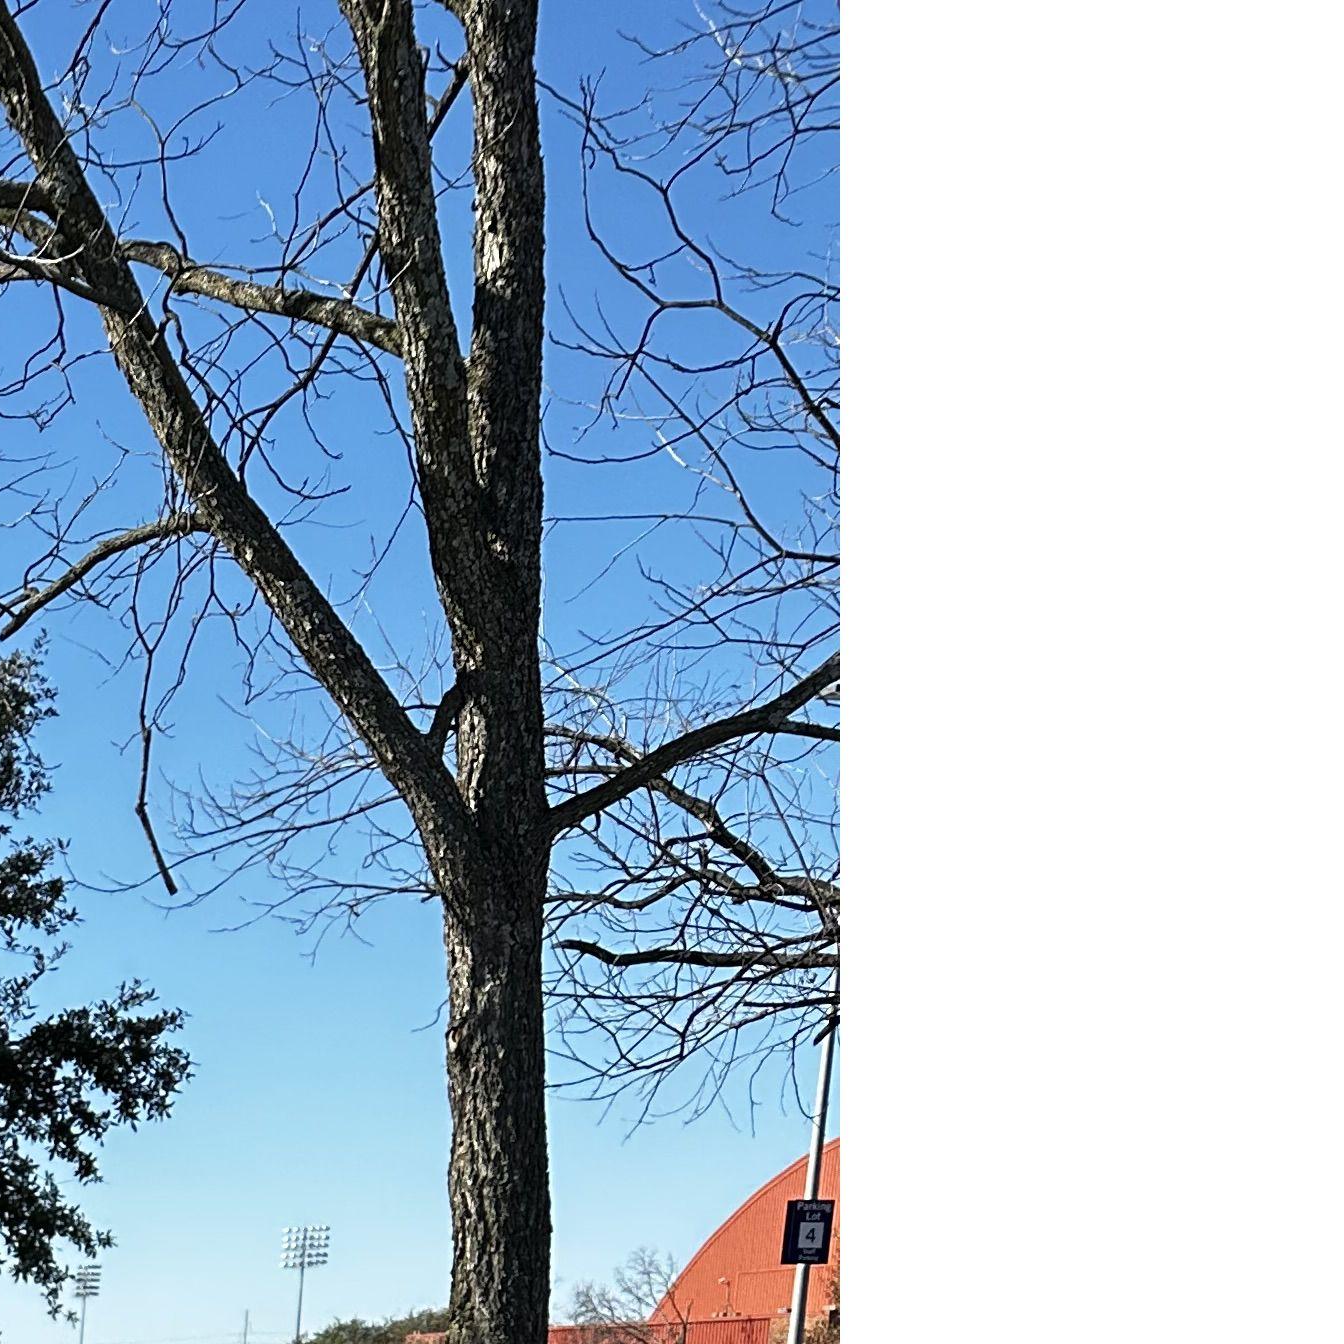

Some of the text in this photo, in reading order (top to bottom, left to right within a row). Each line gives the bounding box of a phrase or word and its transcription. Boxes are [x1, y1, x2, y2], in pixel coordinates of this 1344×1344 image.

[797, 1201, 832, 1213] Parking
[805, 1211, 821, 1221] Lot
[805, 1227, 816, 1242] 4
